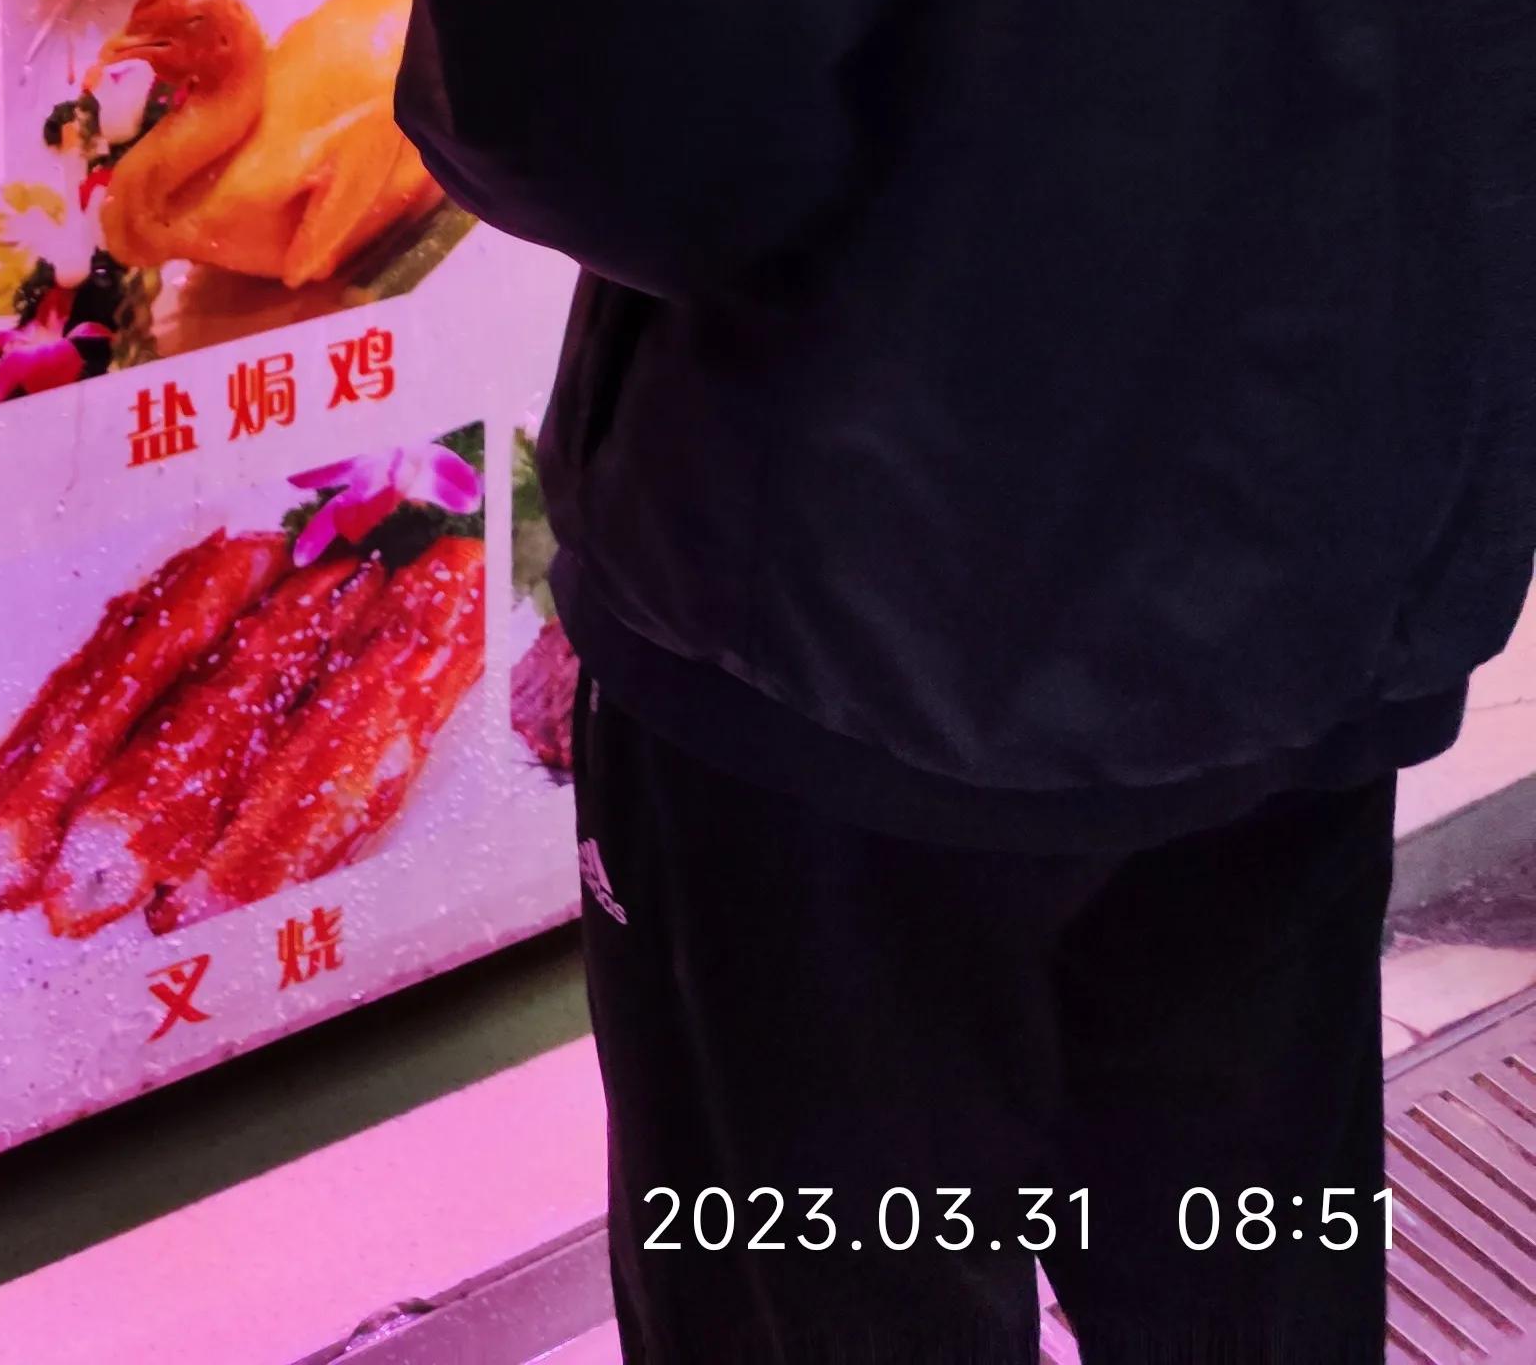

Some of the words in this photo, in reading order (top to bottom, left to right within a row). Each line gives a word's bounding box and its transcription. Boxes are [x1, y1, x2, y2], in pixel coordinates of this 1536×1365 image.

[126, 326, 395, 469] 盐焗鸡
[145, 905, 345, 1046] 叉烧
